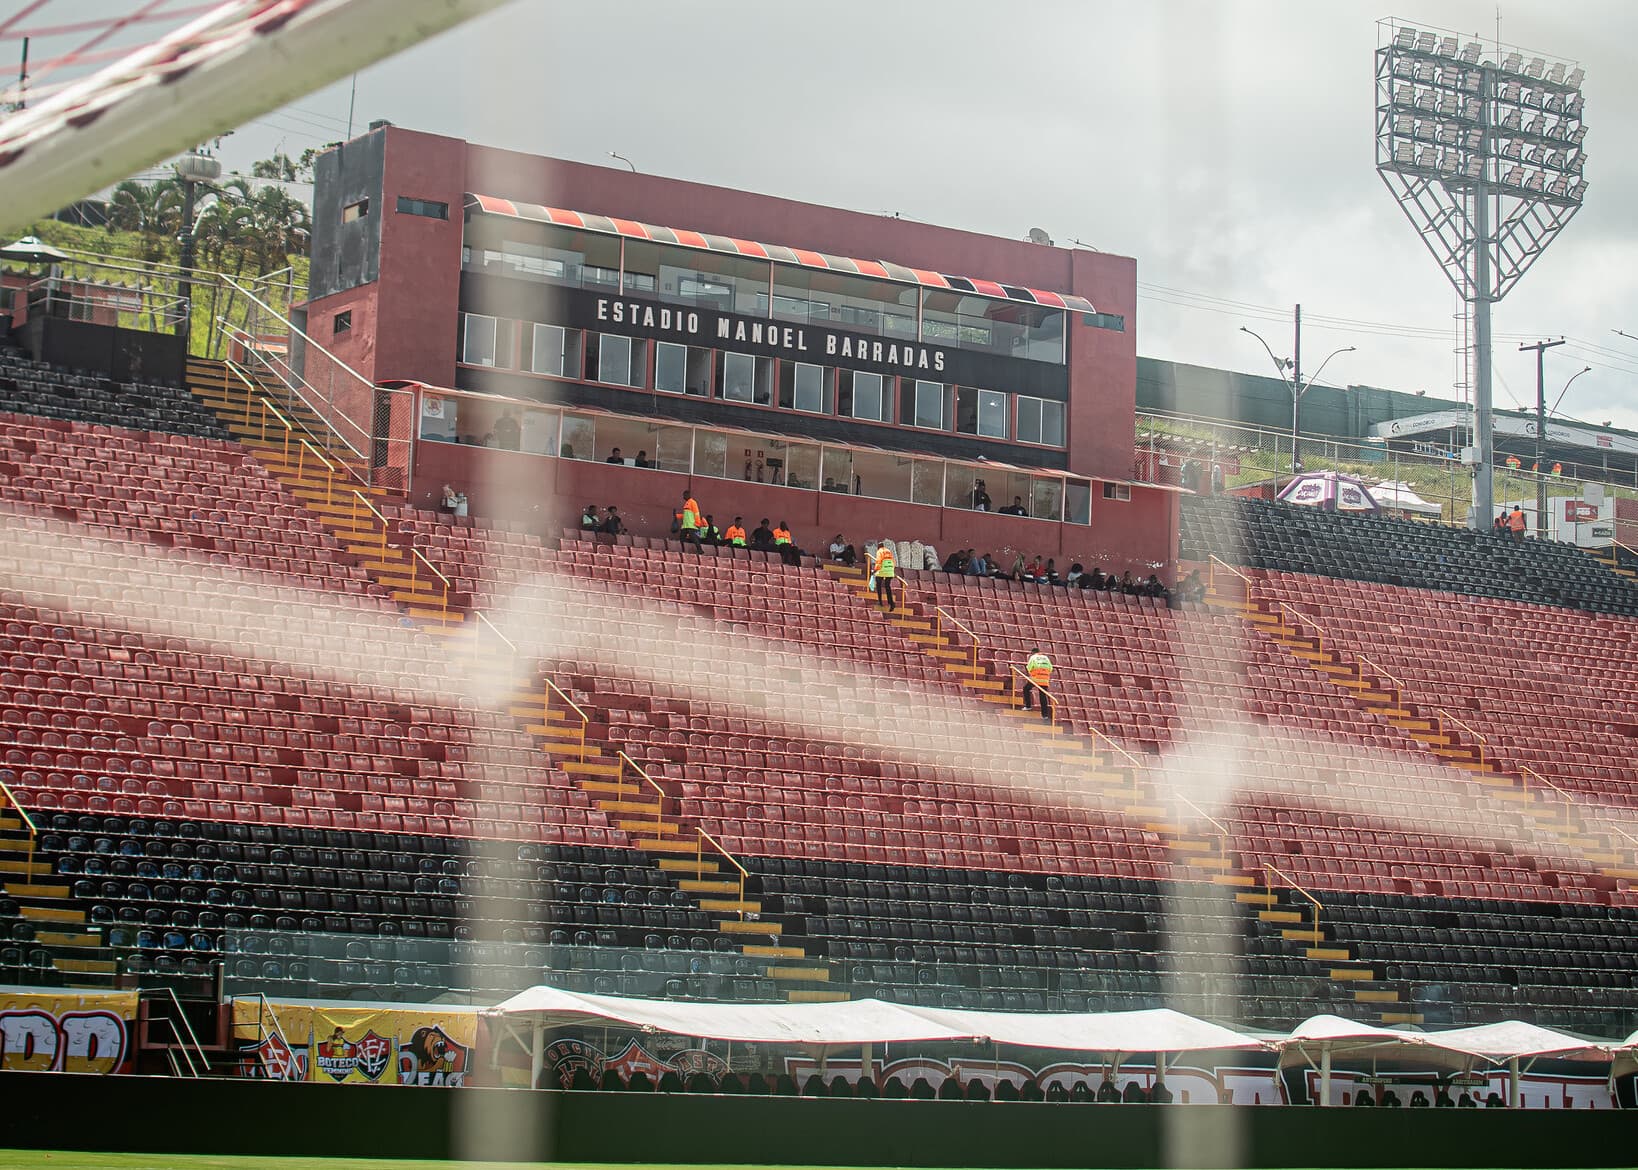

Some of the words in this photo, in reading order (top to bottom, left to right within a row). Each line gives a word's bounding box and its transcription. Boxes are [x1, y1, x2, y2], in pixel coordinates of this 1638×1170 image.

[597, 298, 699, 335] ESTADIO
[717, 317, 808, 352] MANOEL
[826, 334, 946, 372] BARRADAS
[317, 1056, 360, 1068] BOTECO
